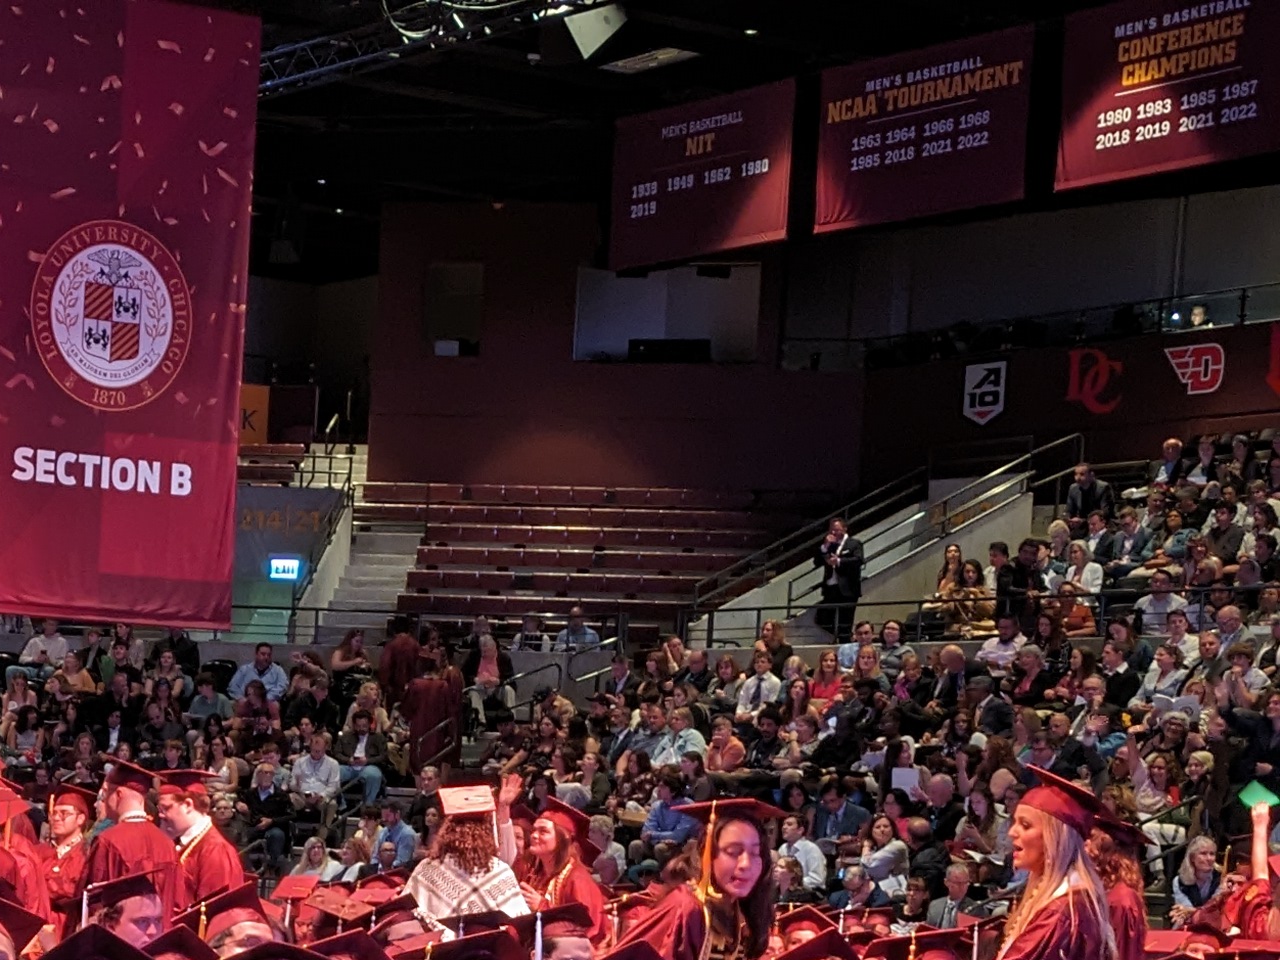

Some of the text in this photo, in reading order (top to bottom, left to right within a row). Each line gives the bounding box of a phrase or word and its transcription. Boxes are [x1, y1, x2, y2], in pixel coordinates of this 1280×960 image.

[1114, 0, 1251, 38] MEN'S BASKETBALL
[1118, 13, 1245, 63] CONFERENCE
[865, 56, 983, 92] MEN'S BASKETBALL
[1122, 40, 1237, 87] CHAMPIONS
[827, 60, 1024, 124] NCAA TOURNAMENT
[1097, 80, 1259, 128] 1980 1983 1985 1987
[685, 132, 715, 156] NIT
[689, 111, 743, 133] BASKETBALL
[851, 110, 990, 151] 1963 1964 1966 1968
[1095, 102, 1258, 150] 2018 2019 2021 2022
[850, 131, 989, 171] 1985 2018 2021 2022
[51, 226, 163, 268] UNIVERSITY
[36, 275, 58, 361] LOYOLA
[162, 278, 187, 375] CHICAGO
[92, 387, 126, 406] 1870
[11, 446, 192, 496] SECTION B
